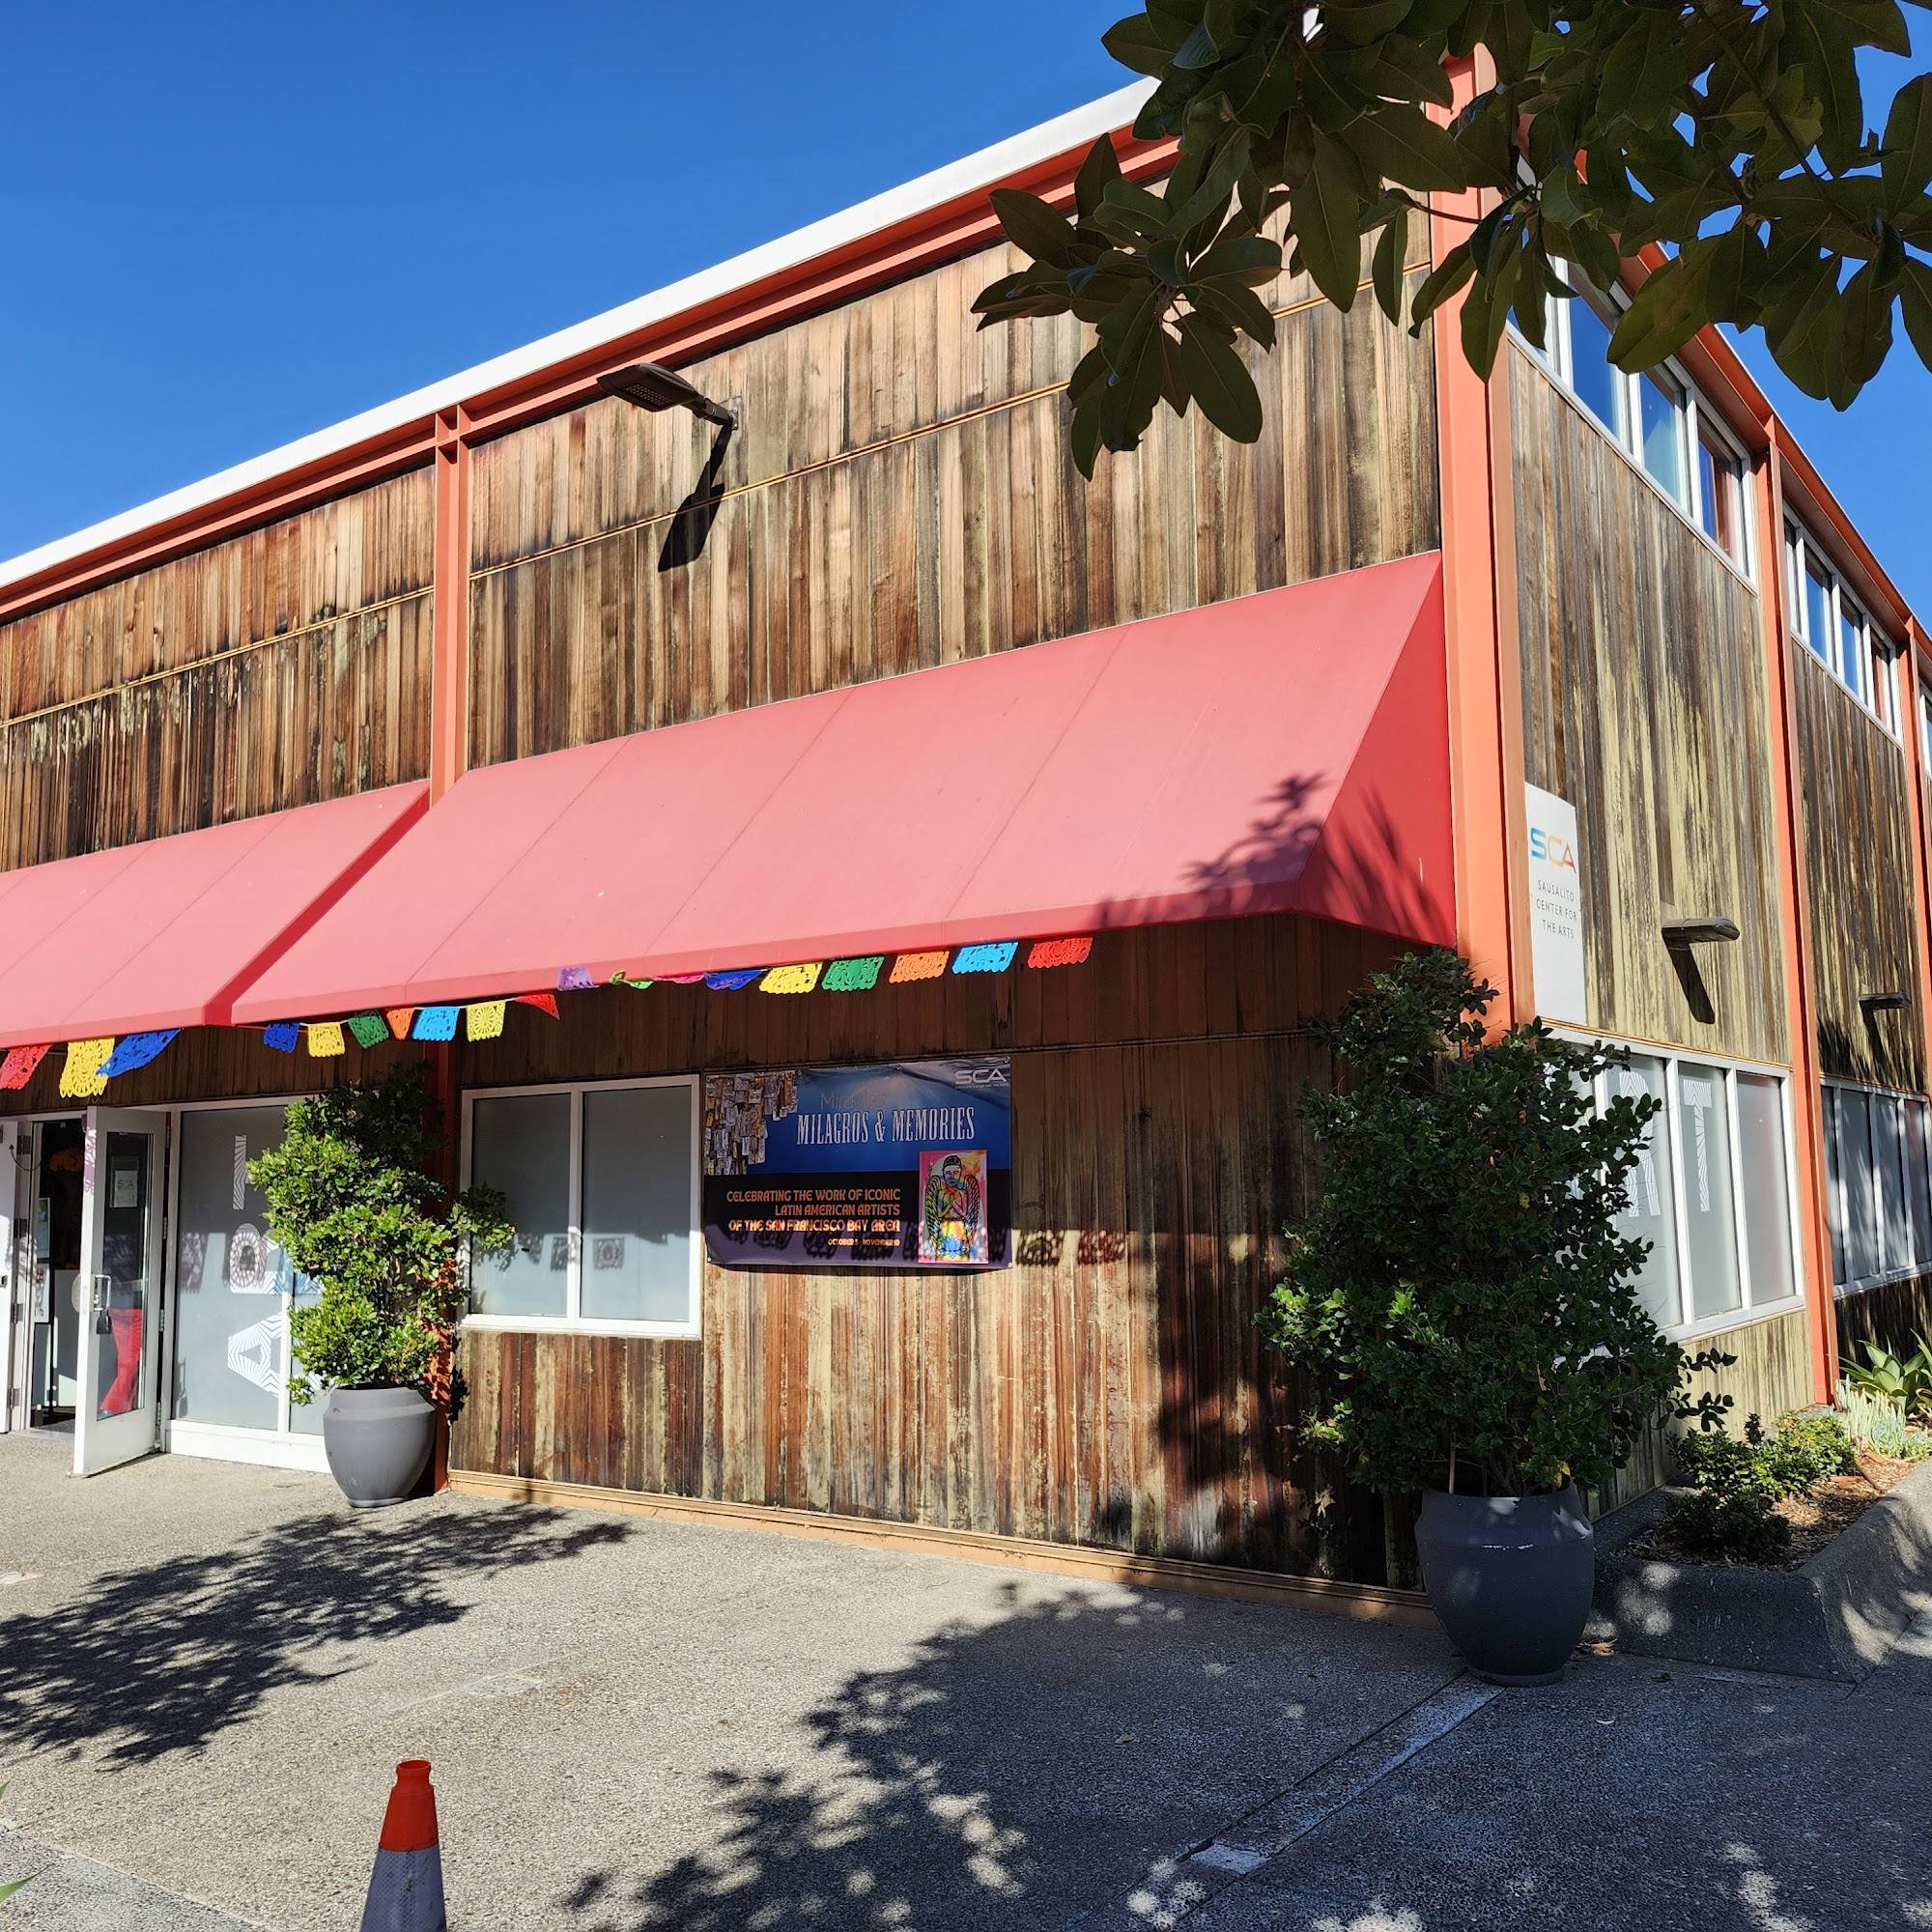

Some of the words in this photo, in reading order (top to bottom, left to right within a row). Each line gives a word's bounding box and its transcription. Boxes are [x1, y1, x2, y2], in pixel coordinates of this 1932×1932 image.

[1530, 827, 1577, 875] SCA
[1537, 879, 1575, 902] SAUSALITO
[1536, 898, 1563, 917] CENTER
[1565, 908, 1577, 923] FOR
[1542, 919, 1556, 934] THE
[1558, 924, 1575, 939] ARTS
[955, 1067, 1008, 1085] SCA
[796, 1111, 869, 1145] MILAGROS
[874, 1110, 887, 1143] &
[891, 1106, 976, 1143] MEMORIES
[726, 1190, 792, 1203] CELEBRATING
[794, 1190, 813, 1202] THE
[815, 1189, 846, 1201] WORK
[848, 1189, 863, 1201] OF
[865, 1188, 901, 1201] ICONIC
[775, 1205, 803, 1216] LATIN
[804, 1204, 856, 1216] AMERICAN
[857, 1204, 900, 1215] ARTISTS
[728, 1219, 743, 1232] OF
[744, 1219, 764, 1232] THE
[765, 1219, 786, 1232] SAN
[786, 1219, 845, 1232] FRANCISCO
[846, 1219, 869, 1232] BAY
[871, 1219, 900, 1232] AREA
